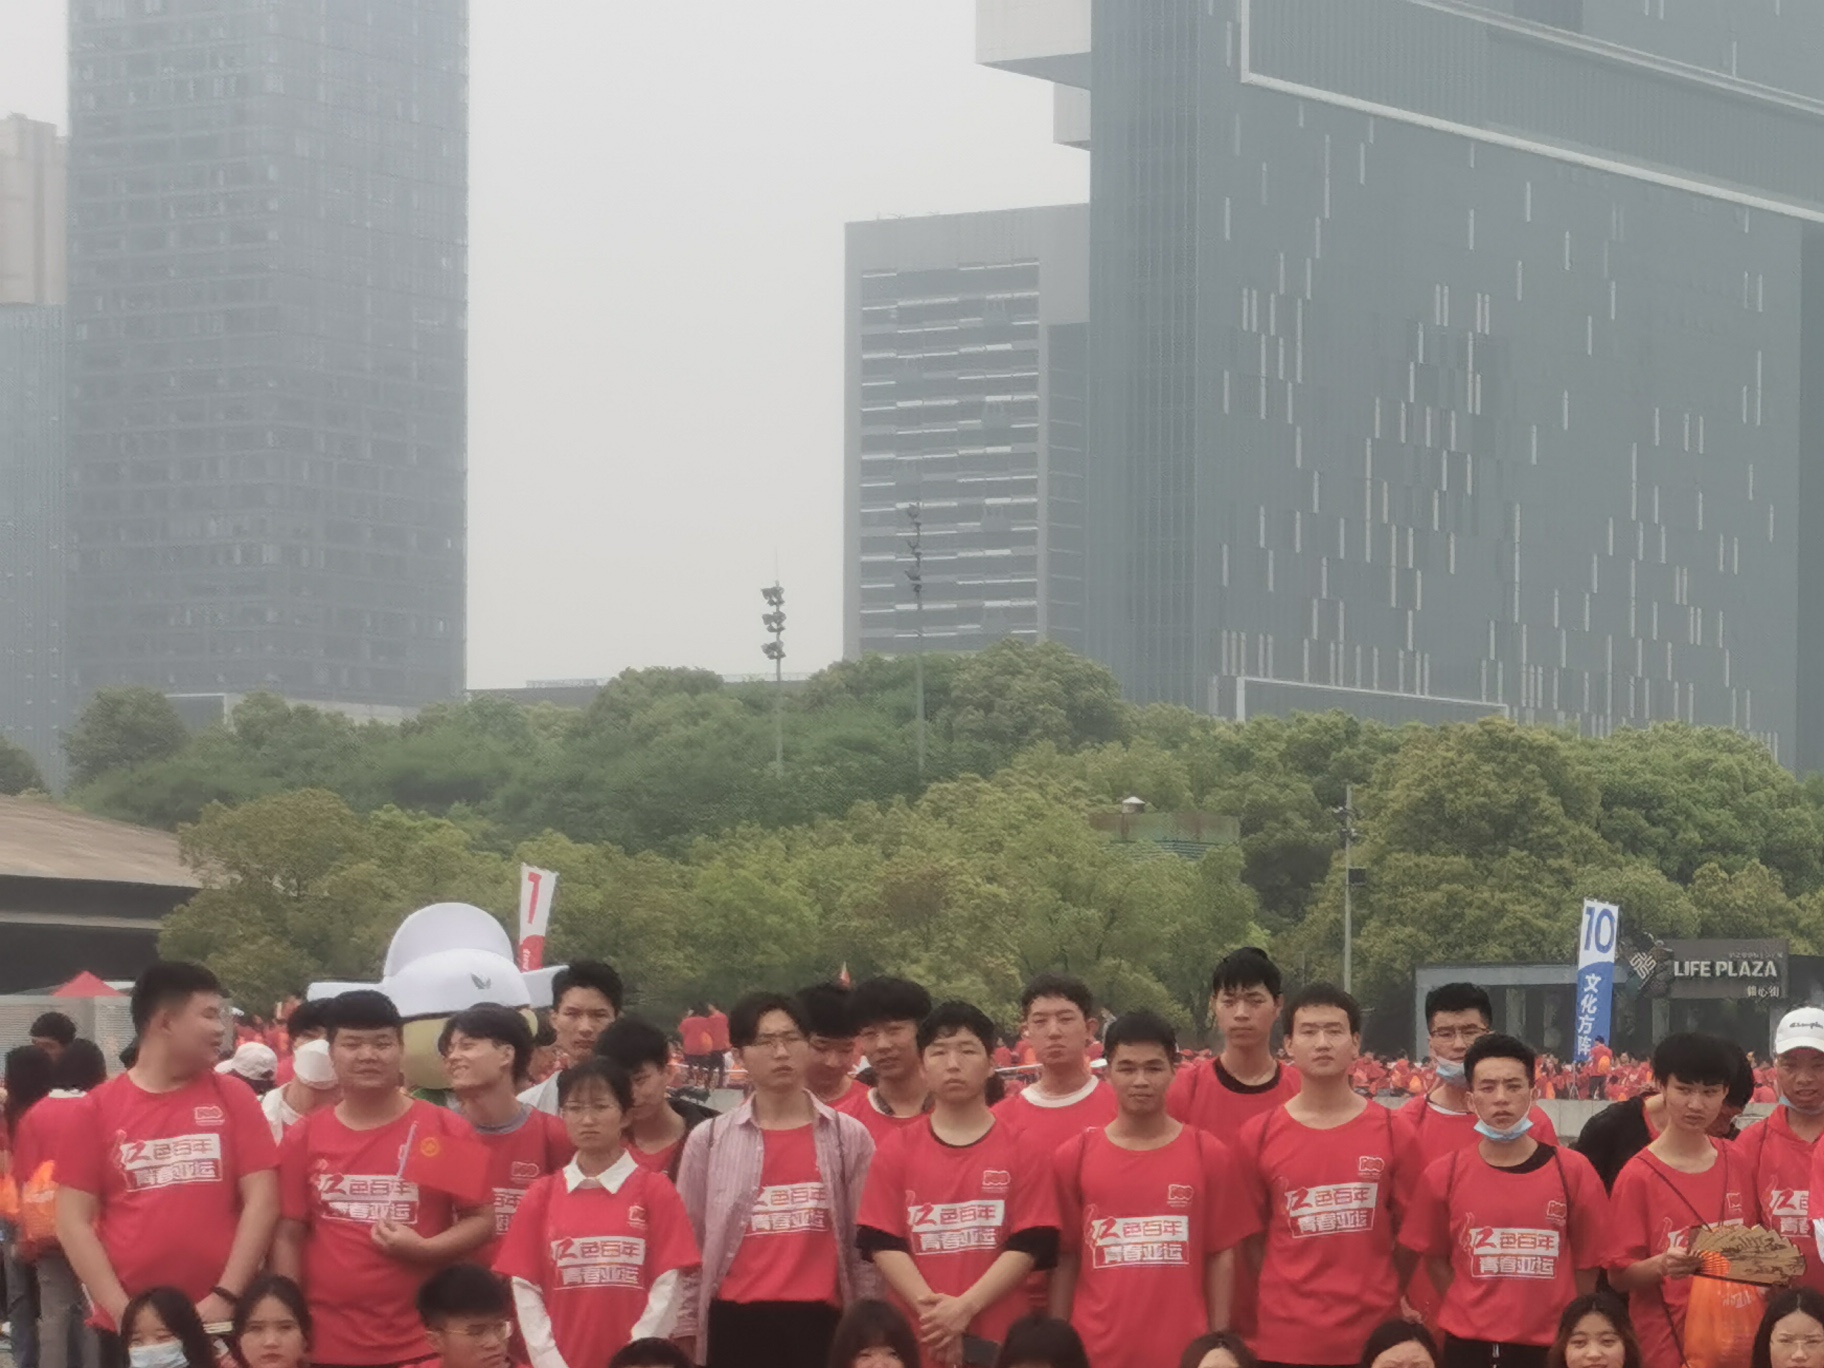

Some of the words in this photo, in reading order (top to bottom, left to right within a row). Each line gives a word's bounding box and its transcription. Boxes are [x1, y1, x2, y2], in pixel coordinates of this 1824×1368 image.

[1584, 907, 1615, 953] 10
[1673, 960, 1711, 977] LIFE
[1715, 960, 1778, 977] PLAZA
[1577, 973, 1601, 1056] 文化方阵
